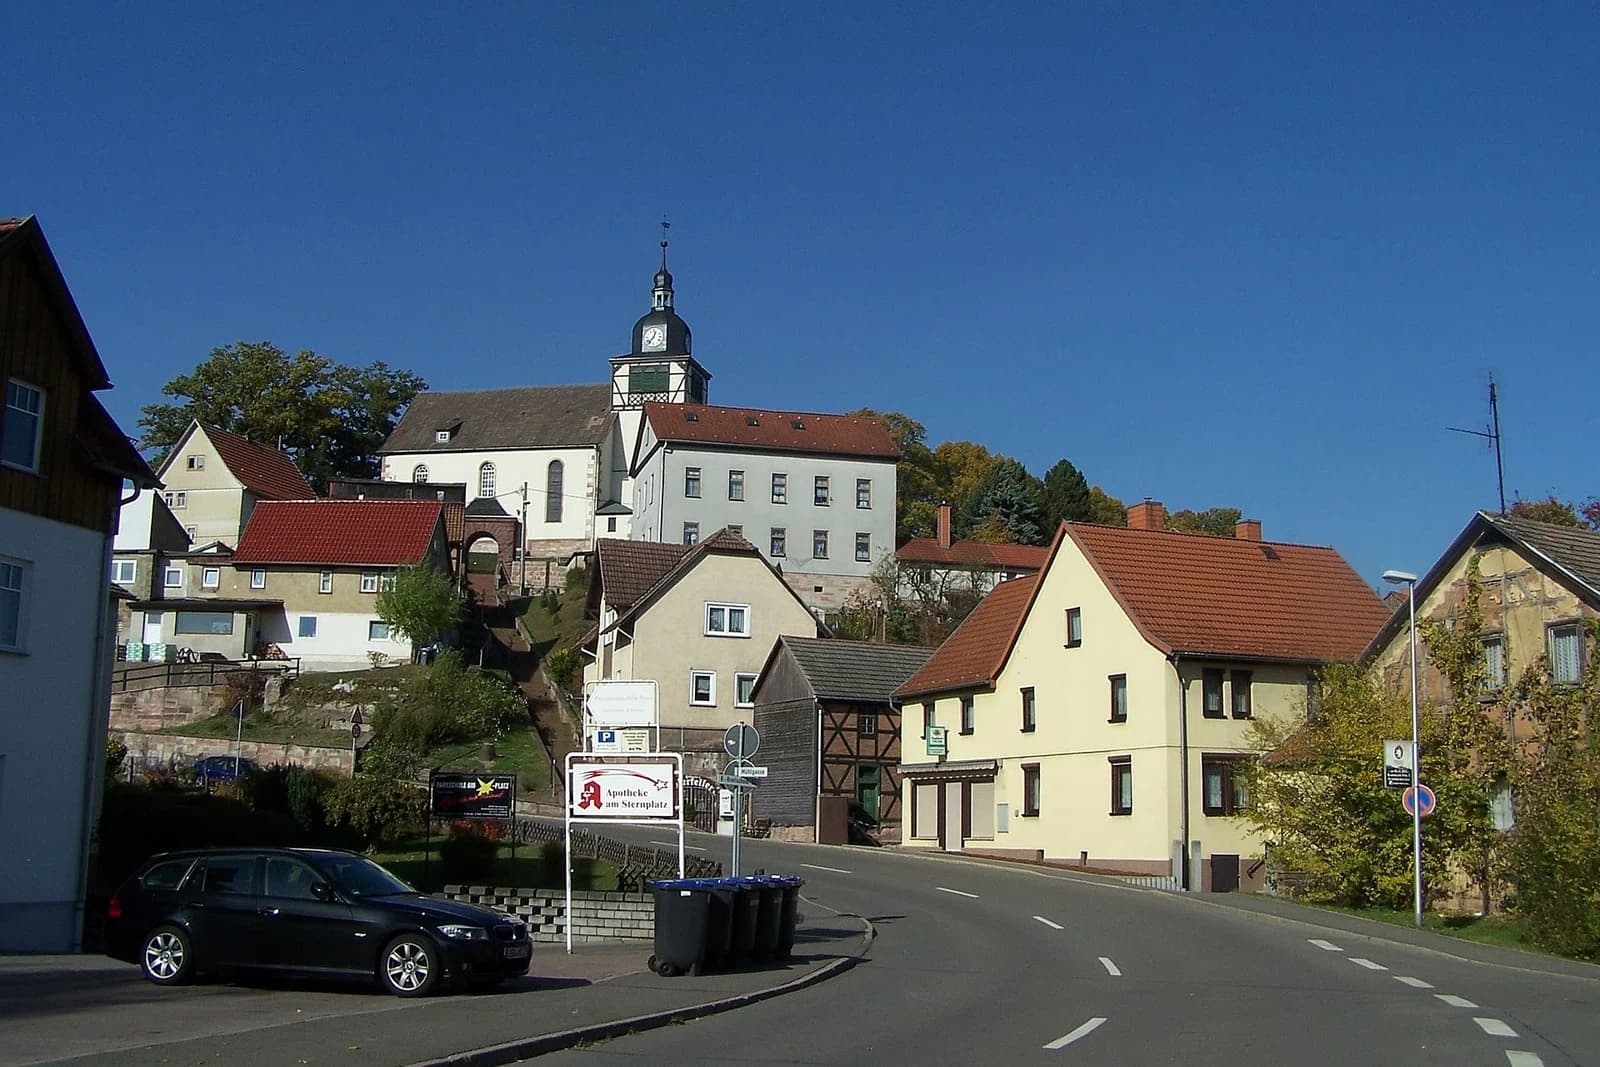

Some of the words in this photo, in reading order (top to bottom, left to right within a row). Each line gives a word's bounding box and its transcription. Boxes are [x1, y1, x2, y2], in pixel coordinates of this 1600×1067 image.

[603, 732, 611, 741] P
[606, 788, 649, 799] Apotheke
[621, 800, 668, 810] Sternplatz
